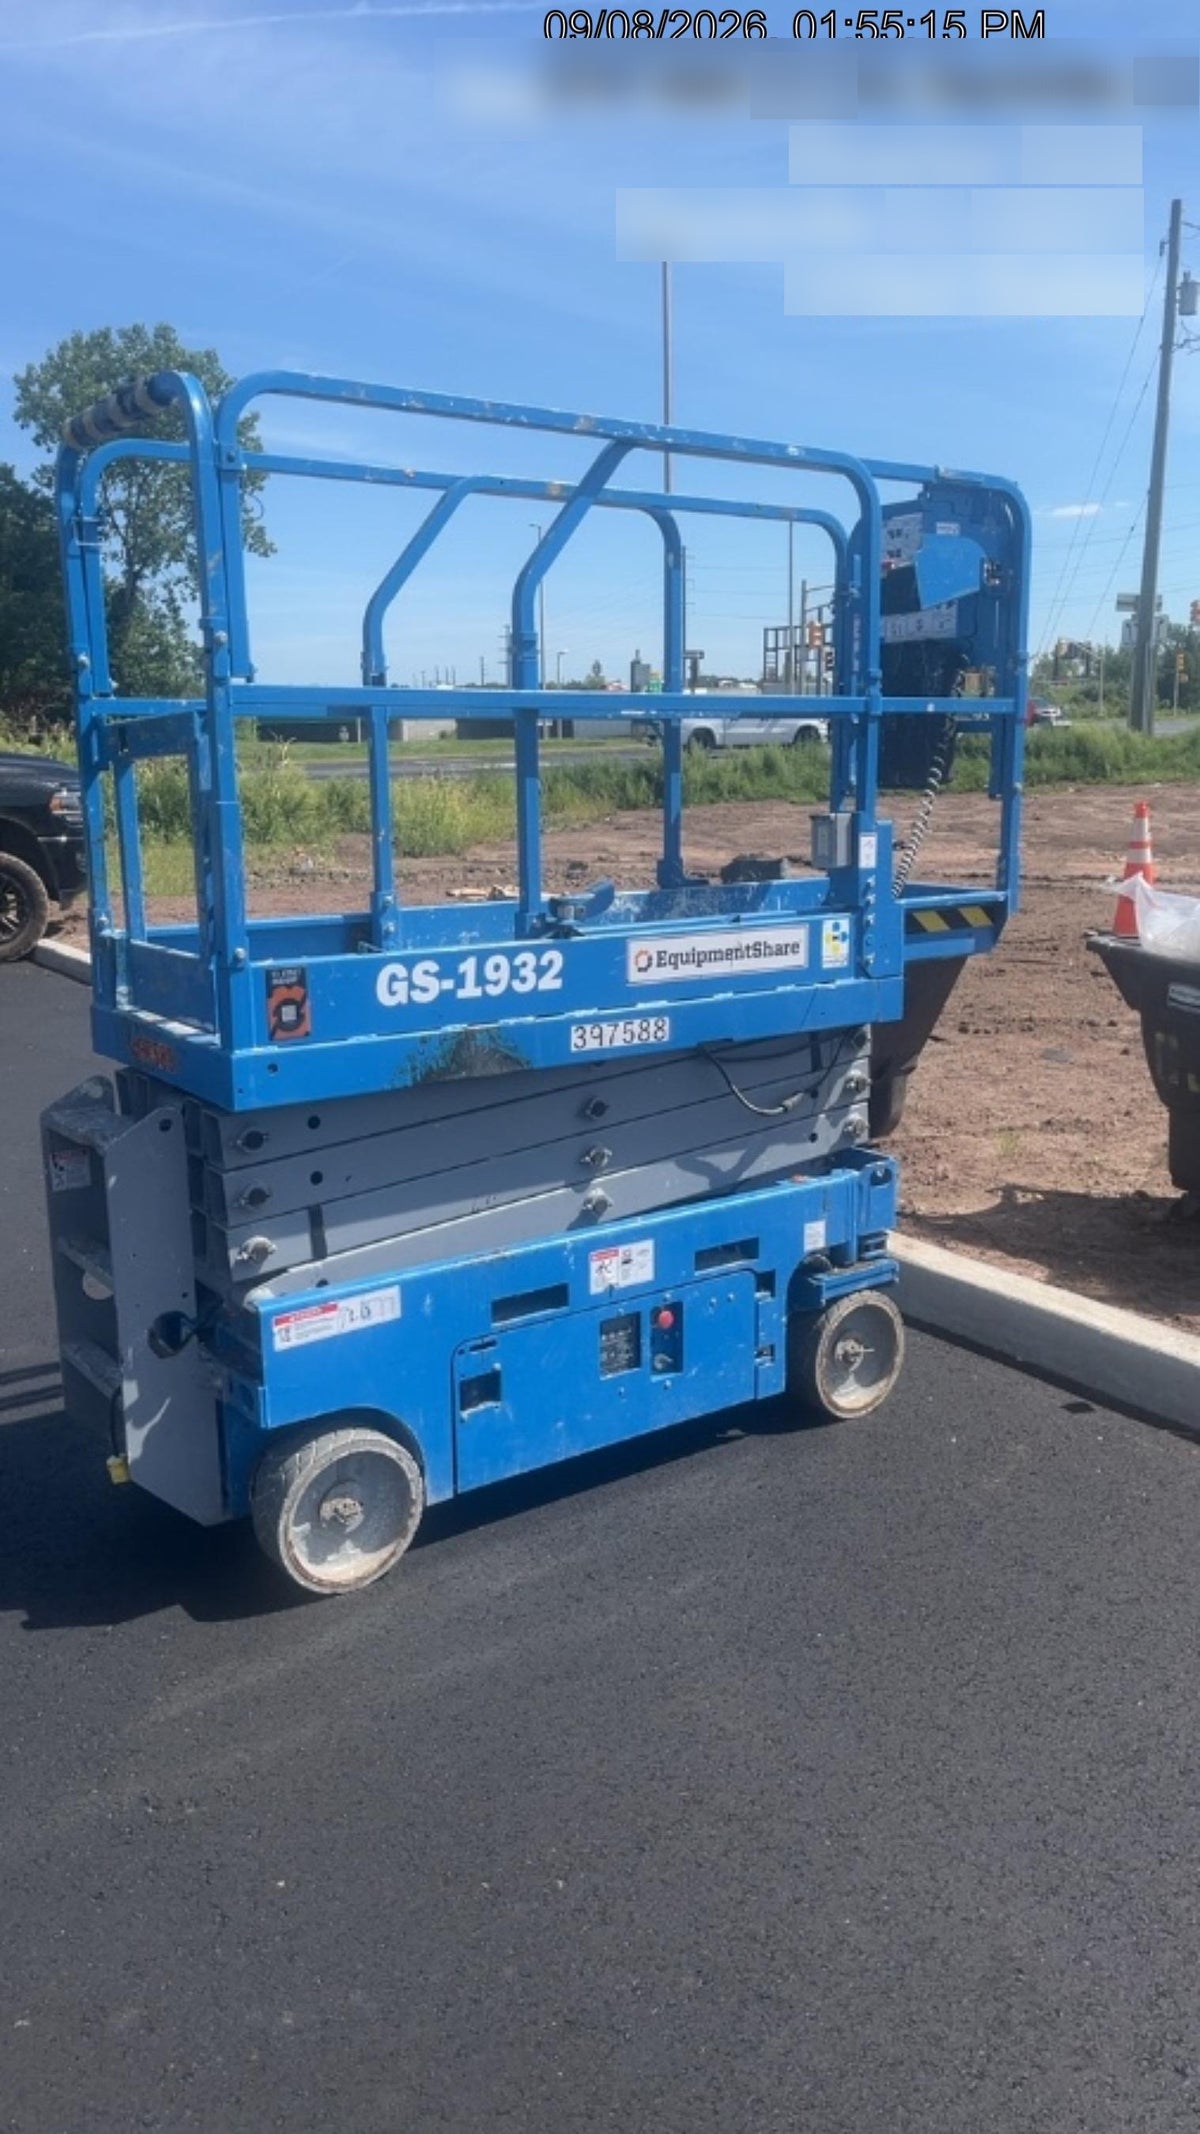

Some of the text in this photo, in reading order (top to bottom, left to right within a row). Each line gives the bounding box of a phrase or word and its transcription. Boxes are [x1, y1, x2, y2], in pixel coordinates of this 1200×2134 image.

[655, 940, 801, 970] EquipmentShare
[376, 950, 564, 1007] GS-1932
[572, 1017, 668, 1051] 397588
